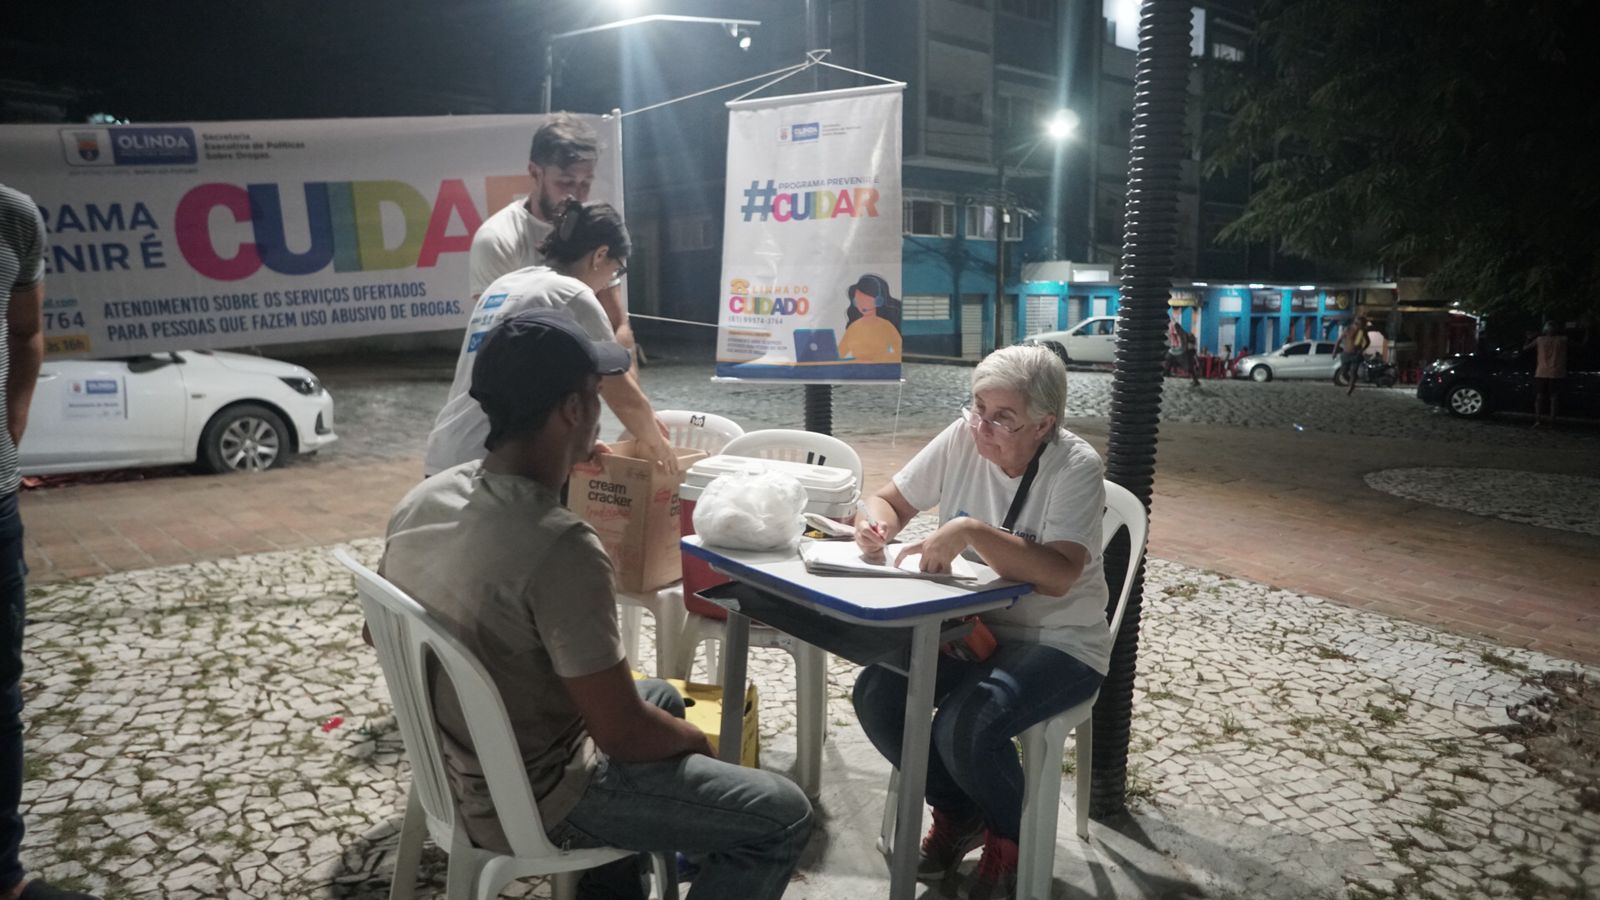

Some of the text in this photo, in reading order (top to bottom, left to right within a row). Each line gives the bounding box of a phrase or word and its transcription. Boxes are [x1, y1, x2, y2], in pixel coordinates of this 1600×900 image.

[117, 134, 190, 149] OLINDA
[778, 179, 825, 189] PROGRAMA
[826, 176, 873, 186] PREVENI
[741, 180, 880, 222] #CUIDAR
[175, 175, 531, 281] CUIDA
[44, 233, 167, 273] NIR É
[793, 286, 809, 294] DO
[104, 282, 427, 319] ATENDIMENTO SOBRE OS SERVIÇOS OFERTADOS
[729, 296, 810, 316] CUIDADO
[43, 311, 85, 330] 764
[107, 323, 149, 341] PARA
[152, 317, 217, 338] PESSOAS
[219, 315, 249, 334] QUE
[252, 311, 297, 331] FAZEM
[301, 310, 328, 327] USO
[331, 305, 387, 324] ABUSIVO
[390, 303, 406, 319] DE
[411, 300, 465, 318] DROGAS.
[588, 479, 627, 495] cream
[587, 490, 633, 507] cracker
